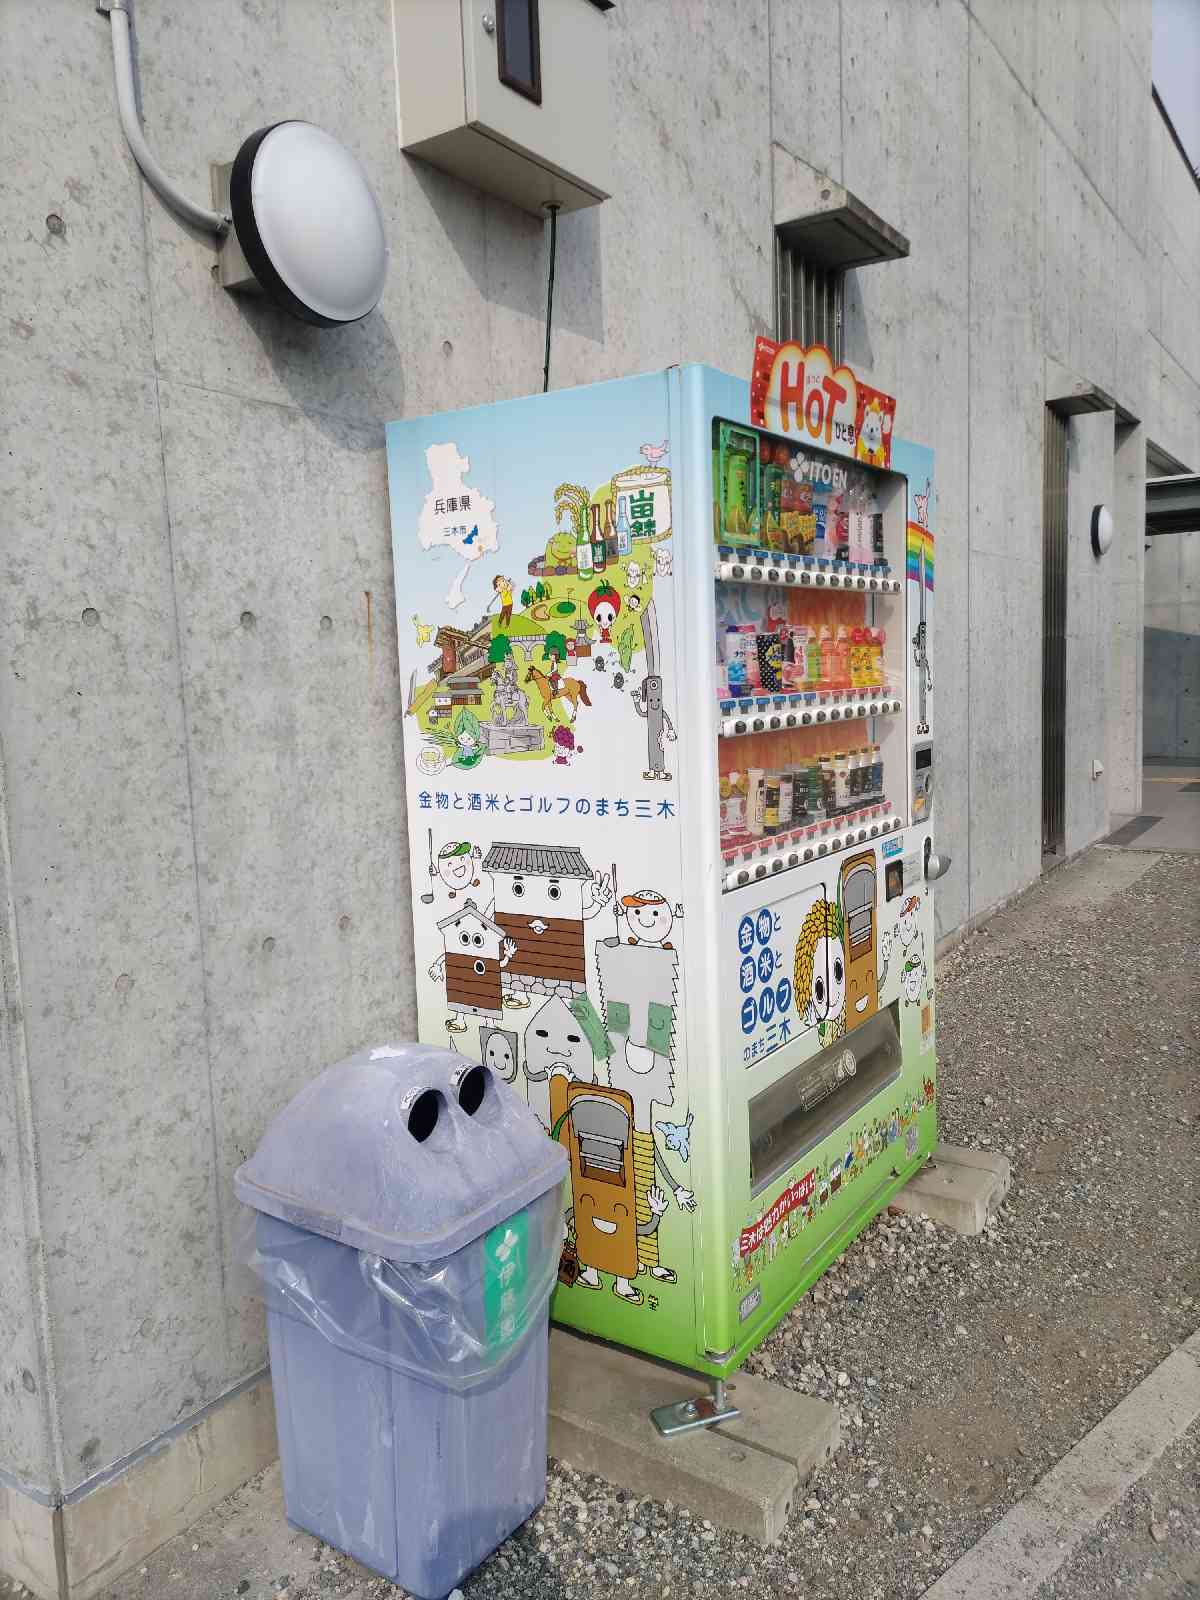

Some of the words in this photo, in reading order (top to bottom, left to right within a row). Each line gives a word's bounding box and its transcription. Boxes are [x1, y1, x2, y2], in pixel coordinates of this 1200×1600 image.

[781, 361, 848, 445] HOT
[809, 461, 832, 486] ITO
[832, 468, 848, 489] EN
[434, 495, 472, 515] 兵庫県
[443, 525, 468, 537] 三木市
[418, 790, 676, 819] 金物と酒米とゴルフのまち三木
[740, 911, 782, 950] 金物と
[740, 950, 783, 990] 酒米と
[741, 982, 790, 1031] ゴルフ
[743, 1016, 791, 1061] のまち三木
